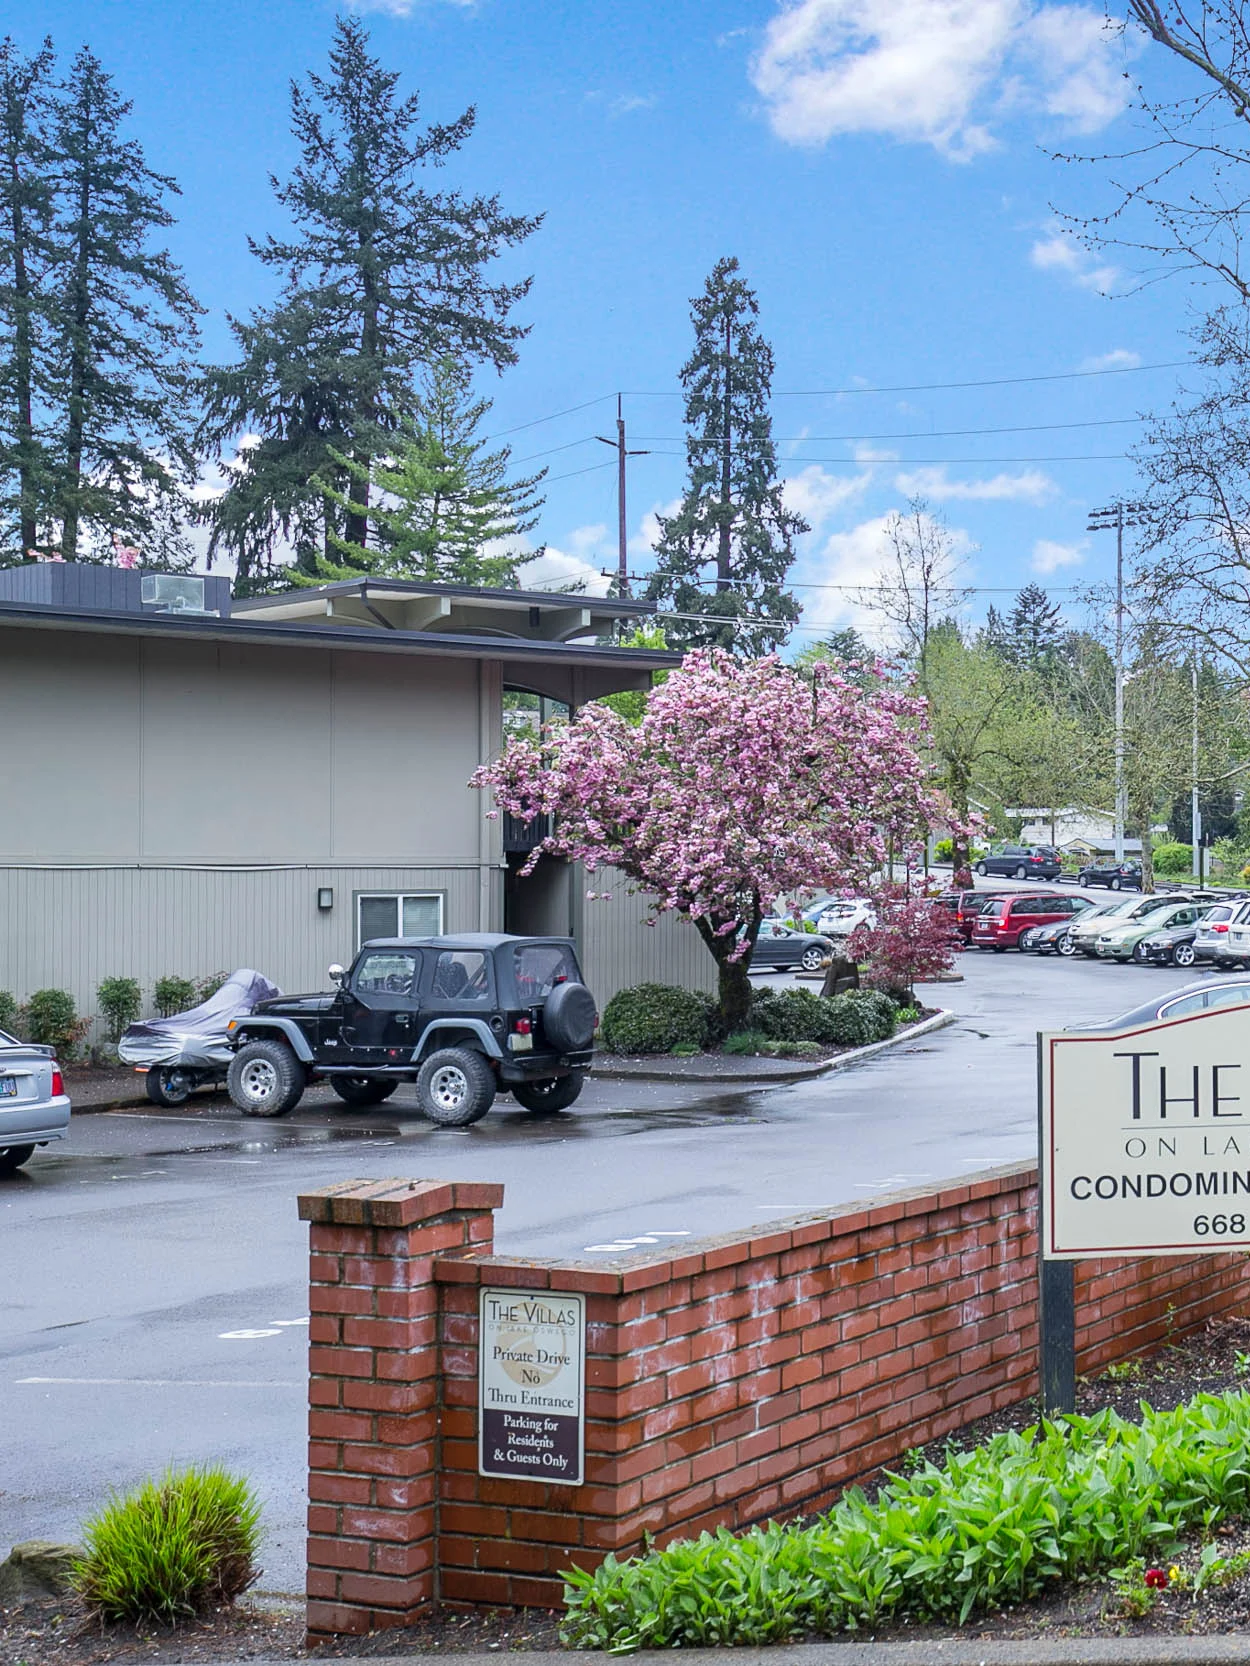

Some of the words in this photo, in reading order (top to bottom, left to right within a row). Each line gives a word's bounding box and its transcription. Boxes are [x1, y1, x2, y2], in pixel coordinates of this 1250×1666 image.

[1113, 1052, 1243, 1119] THE
[1124, 1136, 1177, 1159] ON
[1193, 1213, 1247, 1236] 668
[488, 1300, 518, 1322] THE
[523, 1303, 576, 1326] VILLAS
[493, 1346, 534, 1363] Private
[537, 1349, 570, 1366] Drive
[521, 1369, 541, 1385] No
[488, 1387, 517, 1404] Thru
[521, 1390, 574, 1409] Entrance
[504, 1415, 542, 1433] Parking
[544, 1419, 559, 1431] for
[508, 1432, 554, 1449] Residents
[493, 1449, 505, 1461] &
[507, 1449, 541, 1465] Guests
[542, 1453, 569, 1470] Only
